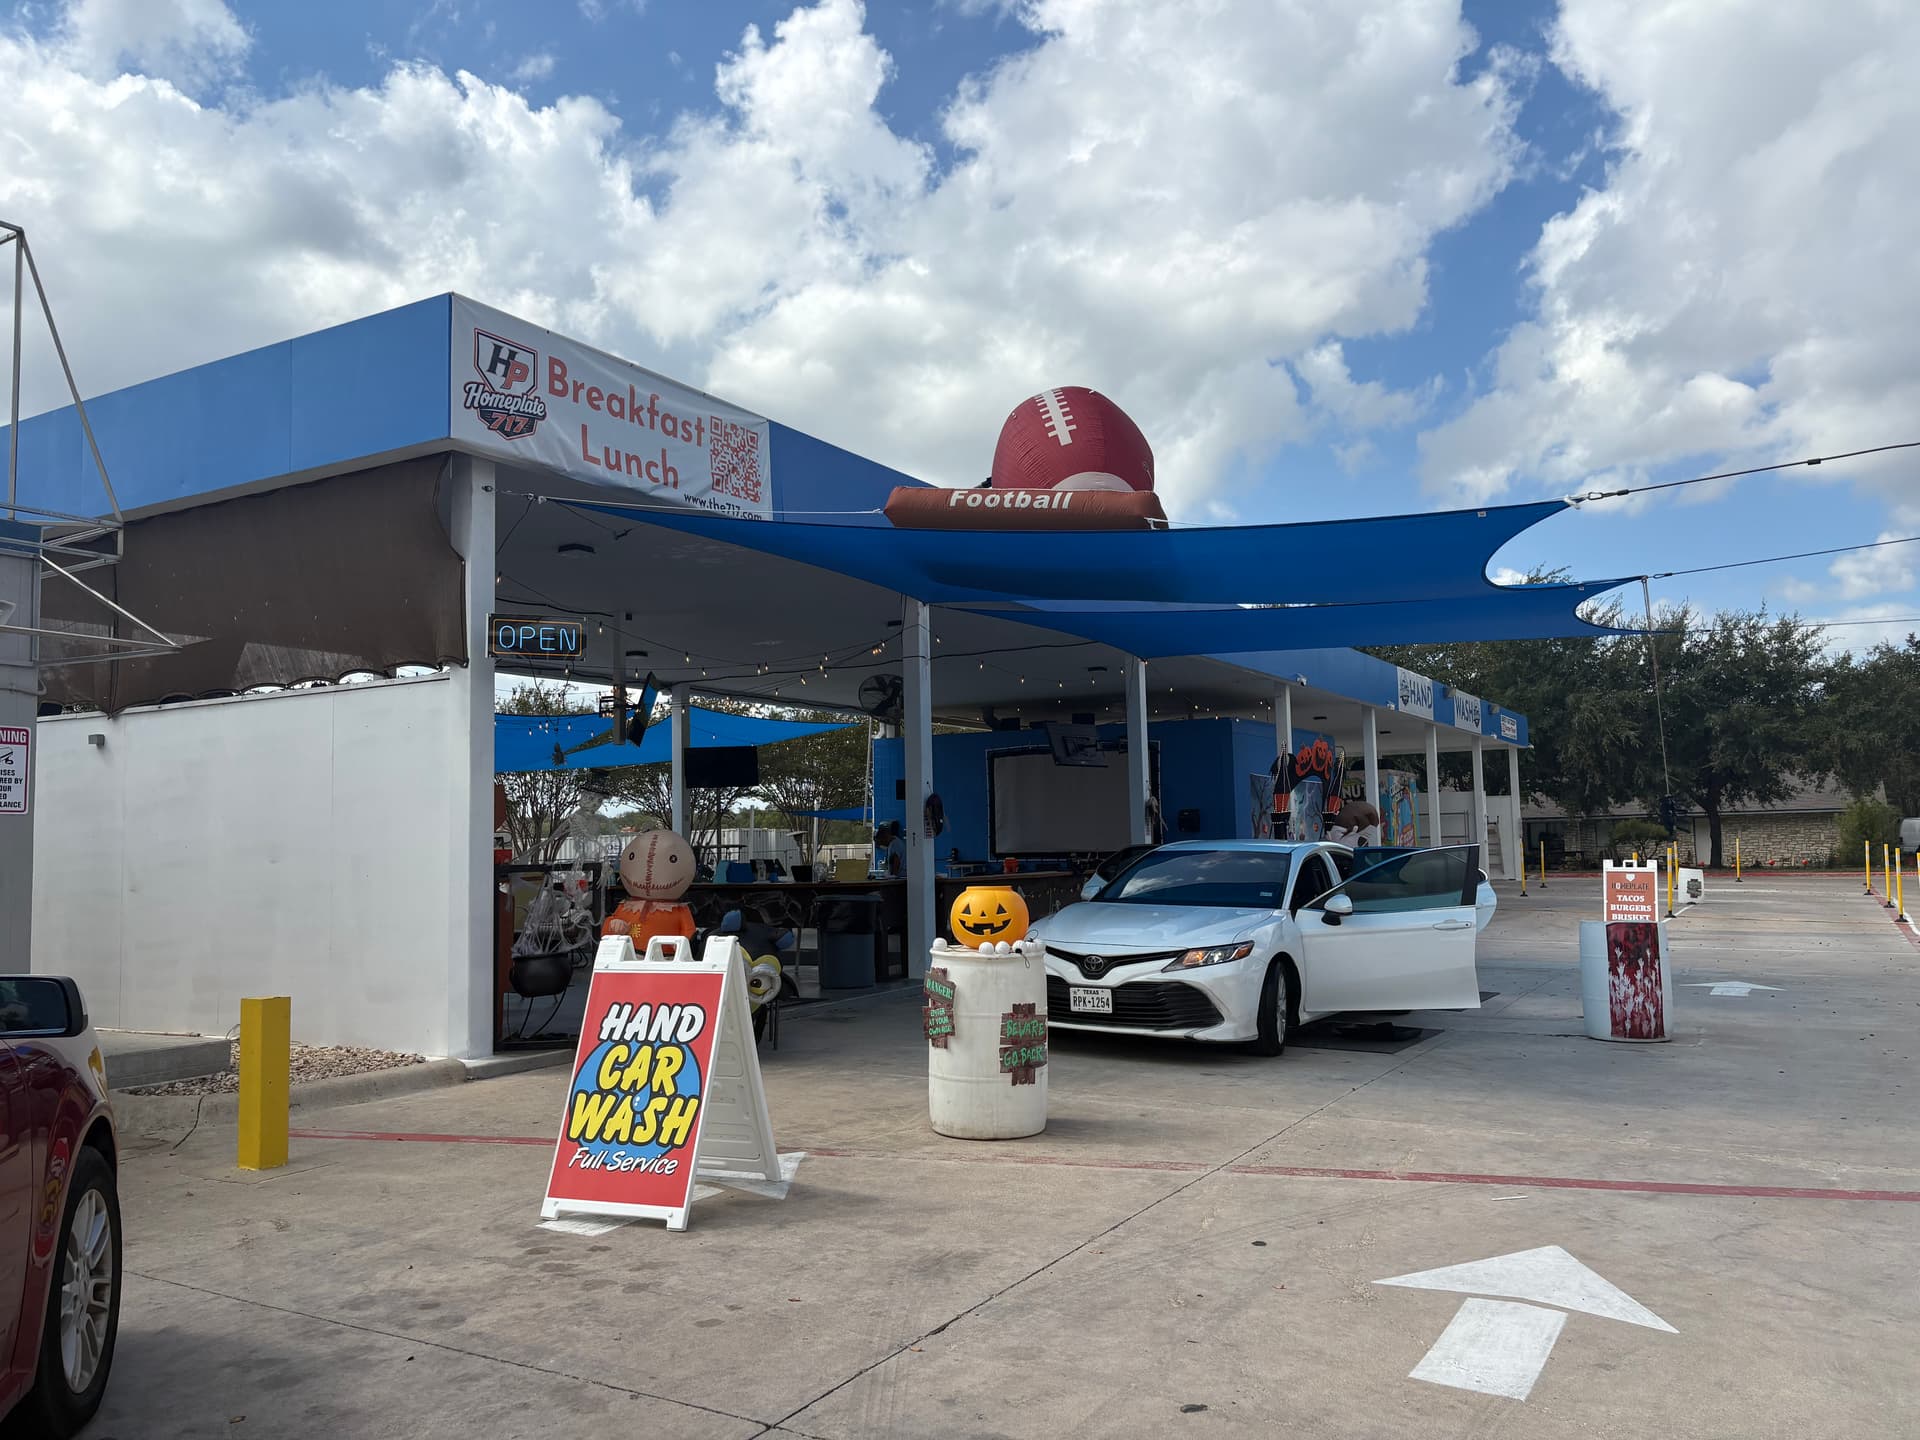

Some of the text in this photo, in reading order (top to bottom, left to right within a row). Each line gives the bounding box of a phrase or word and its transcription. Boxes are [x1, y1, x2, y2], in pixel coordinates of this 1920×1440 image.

[464, 382, 546, 418] Homeplate
[548, 355, 705, 447] Breakfast
[489, 412, 530, 433] 717
[580, 423, 680, 489] Lunch
[950, 490, 1073, 510] Football
[498, 624, 577, 651] OPEN
[1409, 679, 1433, 709] HAND
[1455, 695, 1475, 724] WASH
[1610, 904, 1652, 912] BURGERS
[1616, 894, 1645, 902] TACOS
[1611, 913, 1651, 921] BRISKET
[599, 1003, 704, 1043] HAND
[1006, 1019, 1045, 1038] BEWARE
[598, 1044, 683, 1097] CAR
[1003, 1046, 1044, 1067] GO BACK
[567, 1092, 699, 1145] WASH
[568, 1147, 679, 1175] Full Service
